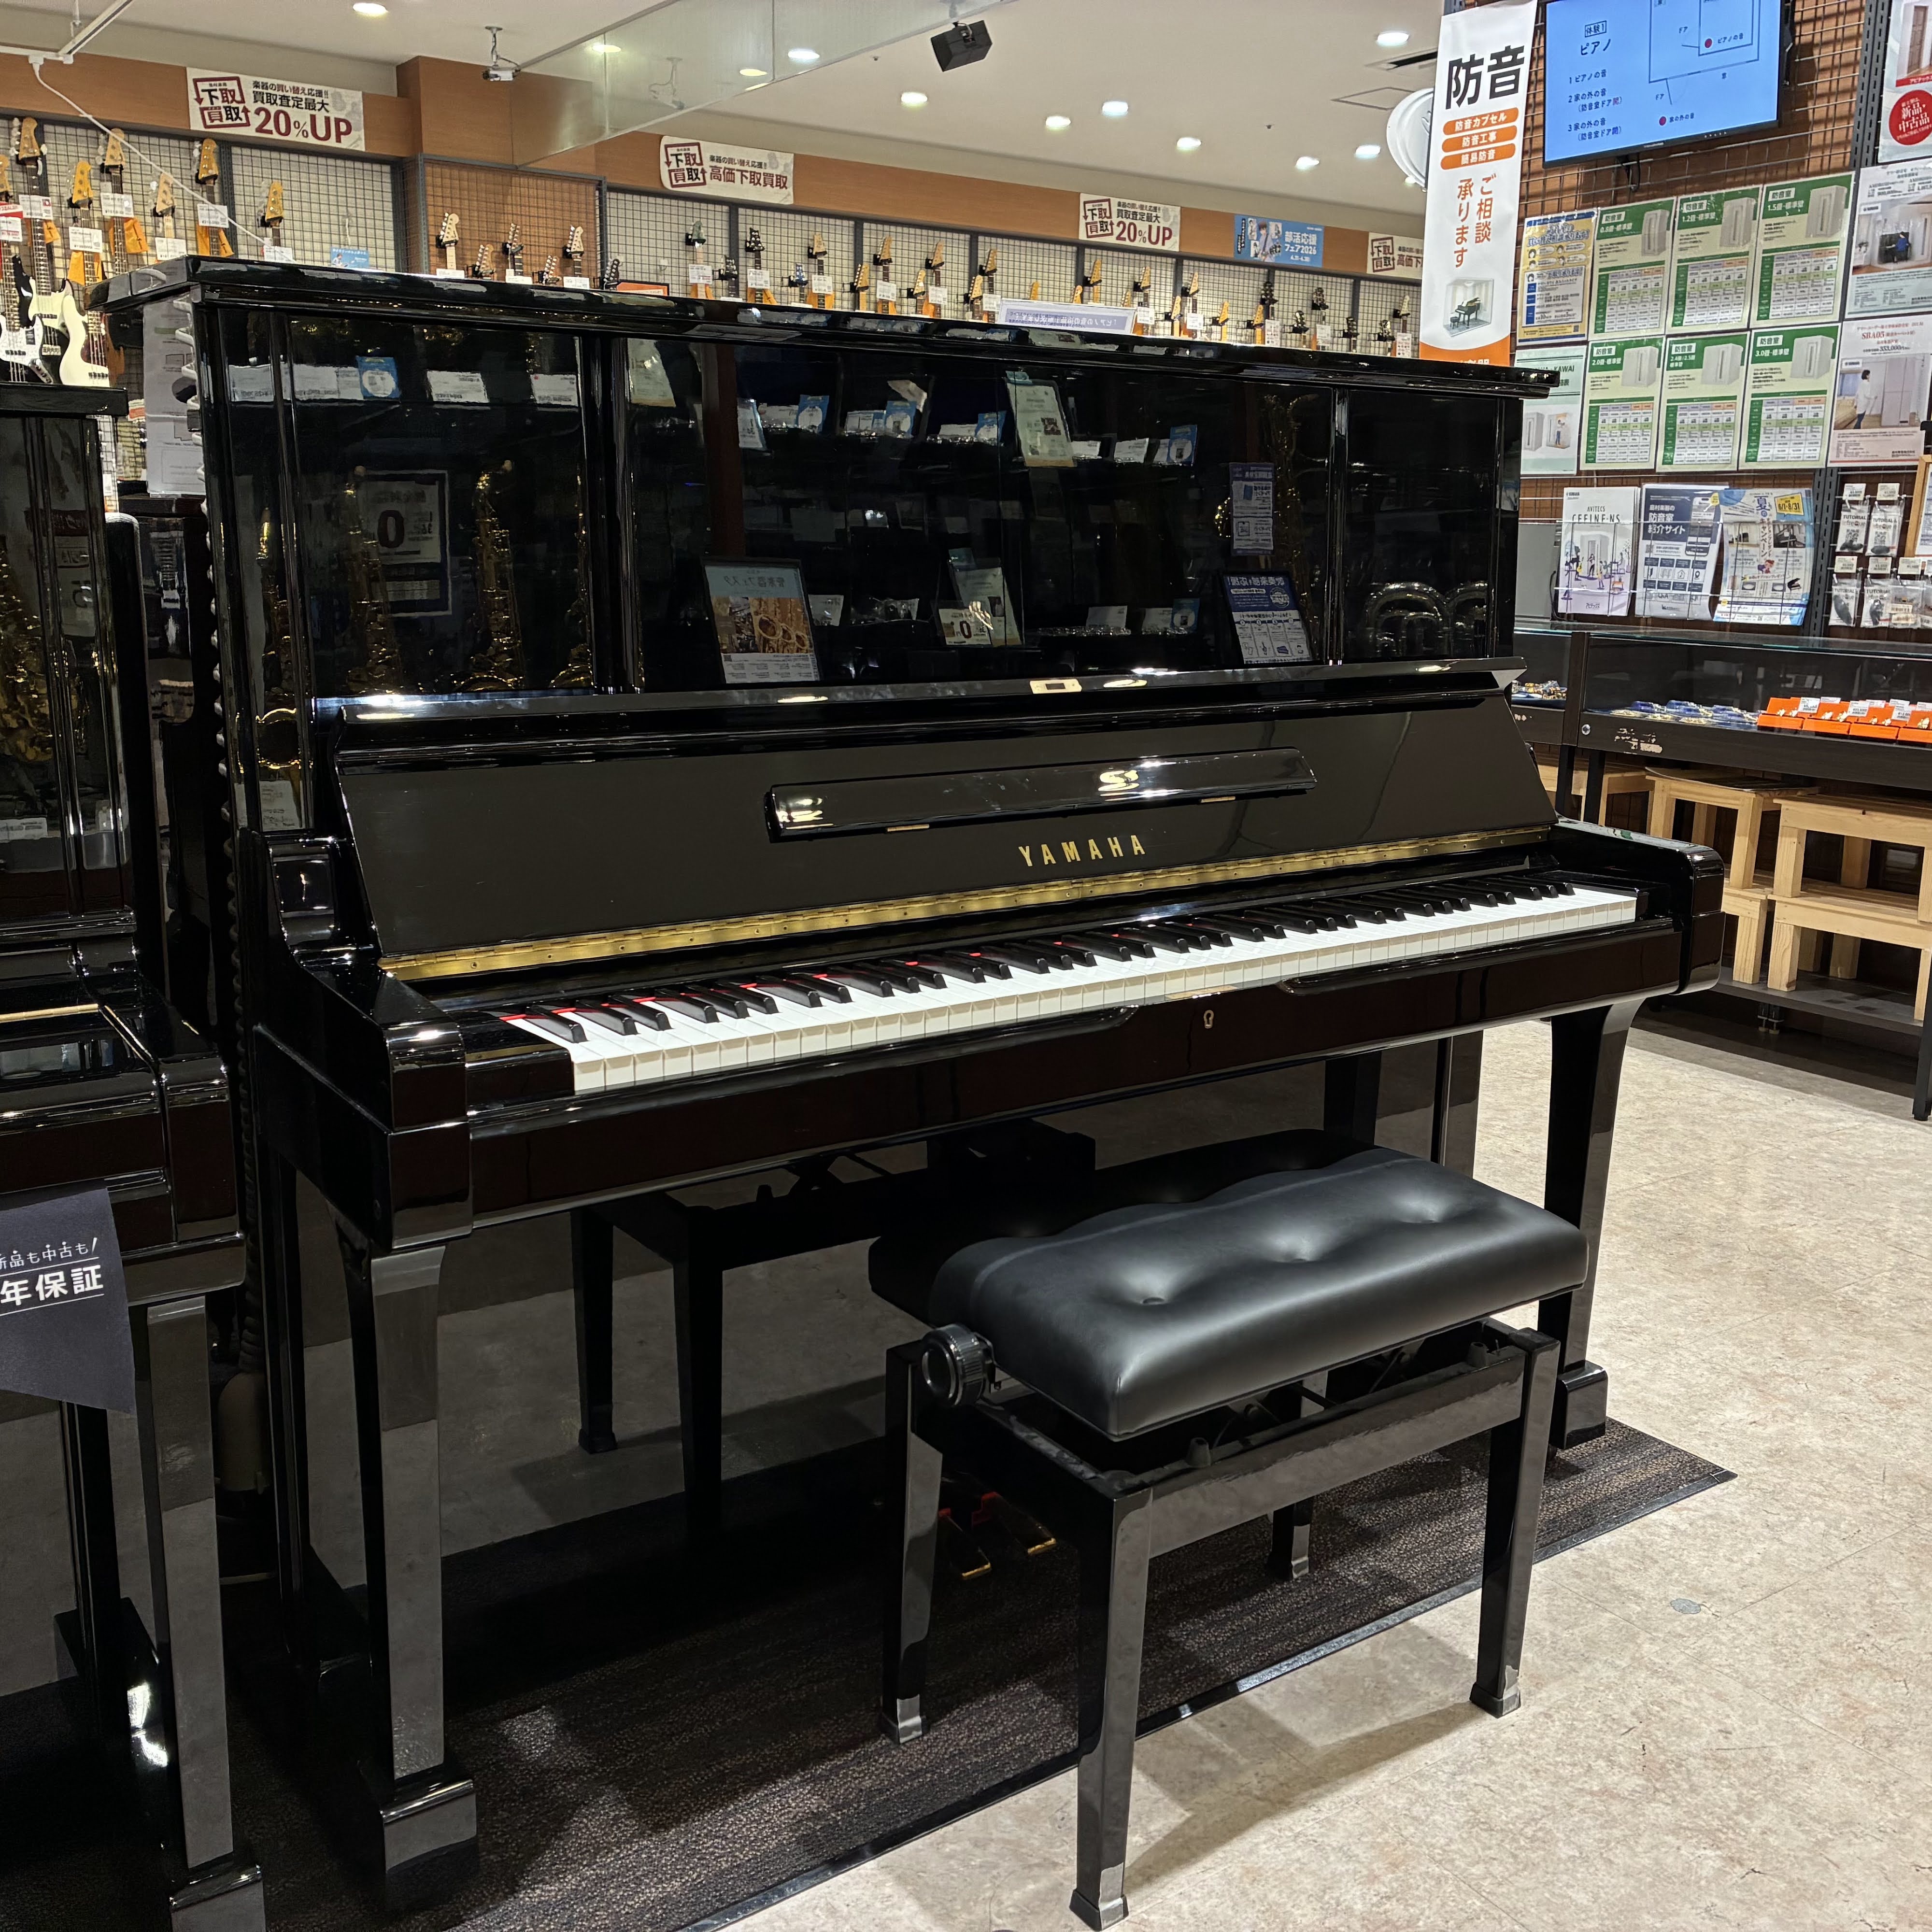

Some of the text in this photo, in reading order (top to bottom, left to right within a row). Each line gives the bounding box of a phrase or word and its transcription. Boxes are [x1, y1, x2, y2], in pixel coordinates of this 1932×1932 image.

[1586, 23, 1605, 35] 体験1
[1581, 39, 1611, 55] ピアノ
[1446, 45, 1525, 110] 防音
[1575, 69, 1606, 83] ピアノの音
[201, 88, 236, 105] 下取
[253, 91, 330, 113] 買取査定最大
[1574, 88, 1606, 102] 家の外の音
[206, 106, 242, 123] 買取
[1455, 112, 1507, 132] 防音カプセル
[1899, 112, 1930, 132] 中古品
[254, 107, 352, 143] 20%UP
[1574, 117, 1606, 131] 家の外の音
[1462, 131, 1497, 147] 防音工事
[670, 153, 697, 168] 下取
[1461, 149, 1495, 165] 簡易防音
[674, 168, 701, 183] 買取
[709, 165, 788, 189] 高価下取買取
[1087, 208, 1108, 220] 下取
[1475, 173, 1496, 243] ご相談
[1117, 209, 1161, 223] 買取査定最大
[1454, 178, 1474, 268] 承ります
[1090, 221, 1109, 232] 買取
[1116, 221, 1172, 246] 20%UP
[1285, 231, 1317, 245] 部活応援
[1284, 244, 1317, 255] フェア2026
[1374, 245, 1390, 257] 下取
[1397, 254, 1422, 268] 高価下
[1754, 496, 1770, 511] 夏
[1648, 512, 1674, 523] 防音室
[1648, 524, 1686, 535] 紹介サイト
[1018, 835, 1145, 867] YAMAHA
[0, 1265, 104, 1306] 年保証
